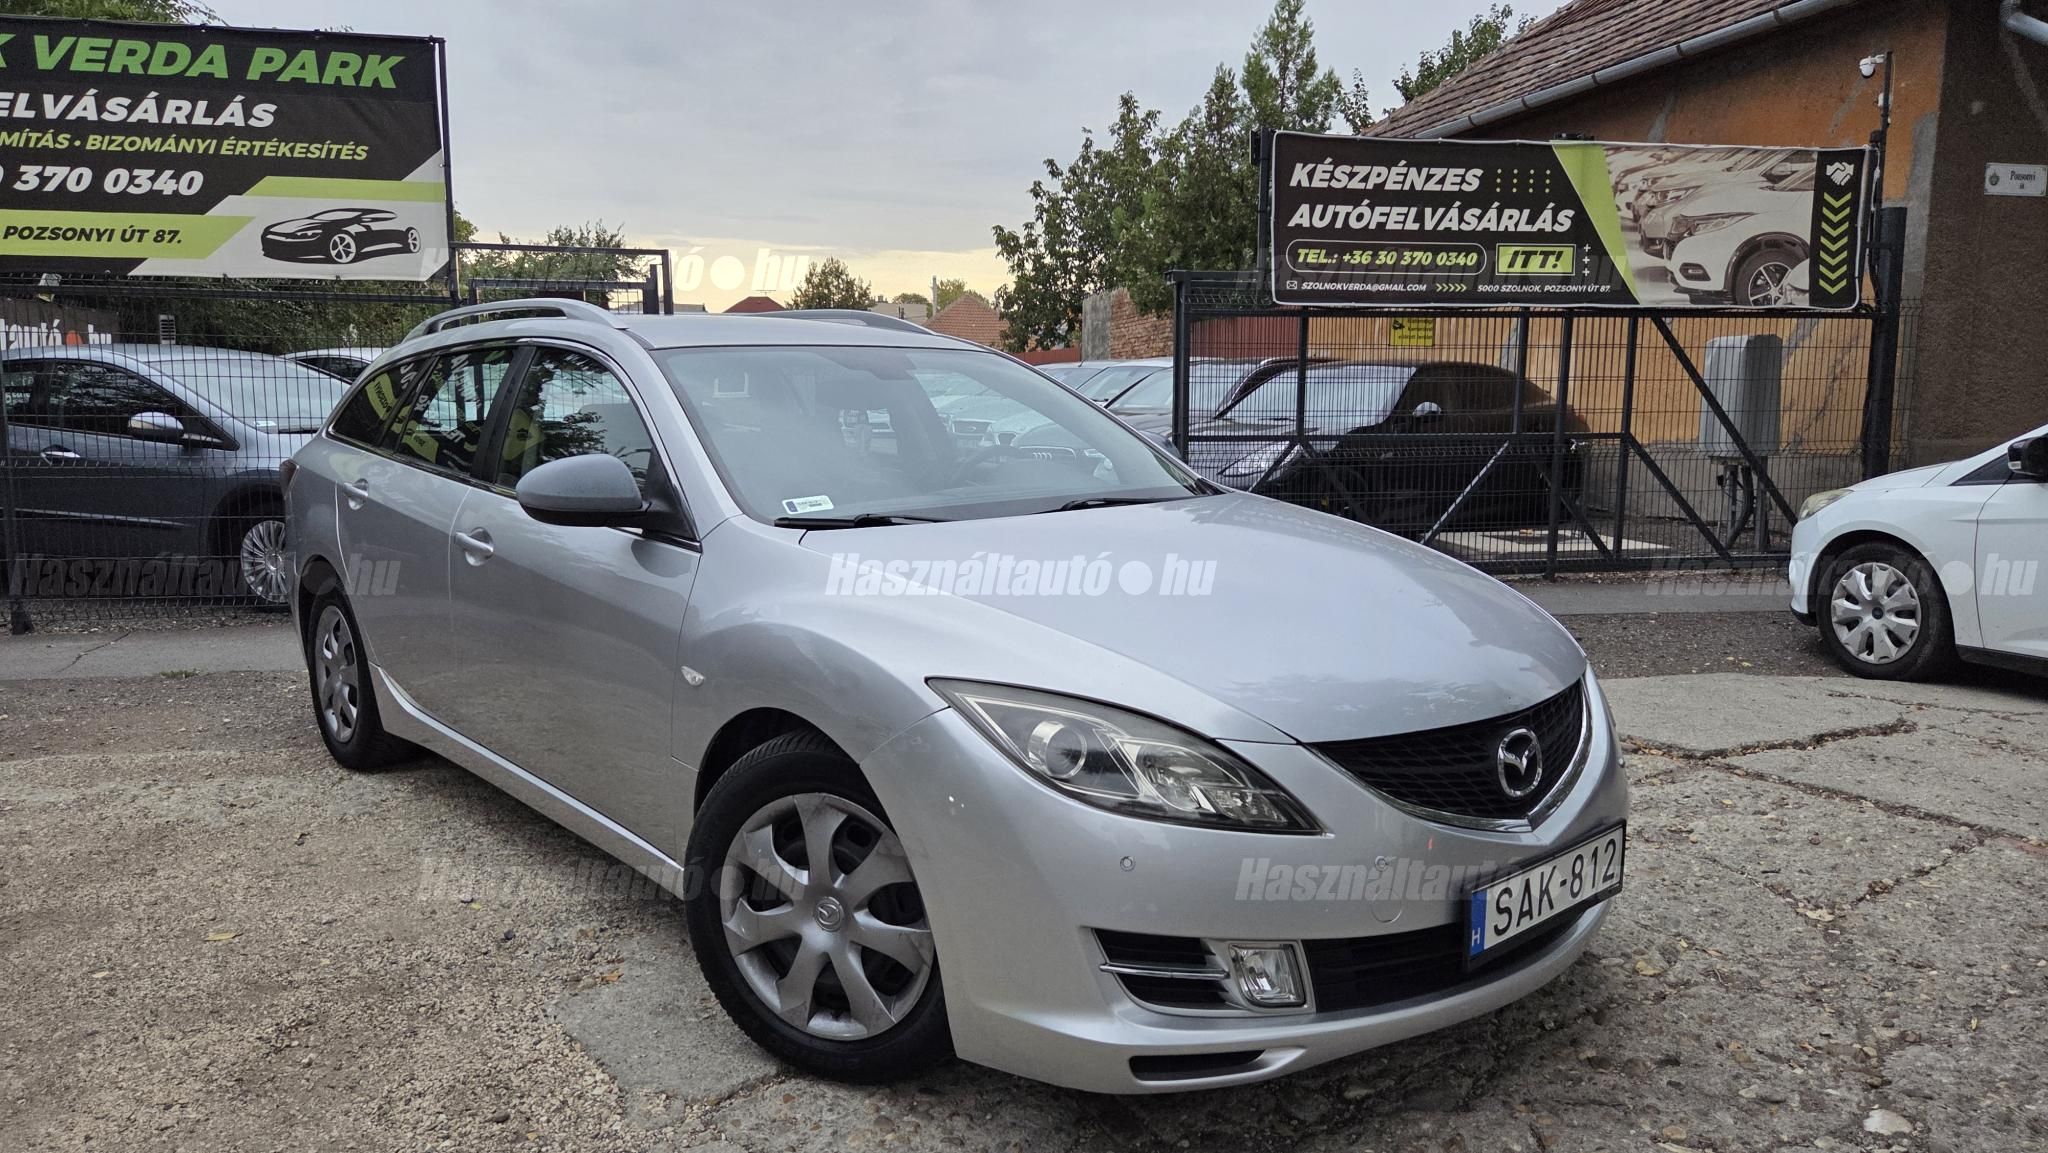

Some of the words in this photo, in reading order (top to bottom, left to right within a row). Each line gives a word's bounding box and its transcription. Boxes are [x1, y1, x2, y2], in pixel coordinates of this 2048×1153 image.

[34, 34, 229, 79] VERDA
[247, 48, 406, 89] PARK
[85, 131, 217, 155] BIZOMÁNYI
[220, 136, 369, 161] ÉRTÉKESÍTÉS
[13, 165, 93, 192] 370
[103, 167, 204, 196] 0340
[1289, 157, 1484, 192] KÉSZPÉNZES
[1287, 199, 1576, 233] AUTÓFELVÁSÁRLÁS
[3, 225, 116, 242] POZSONYI
[120, 225, 149, 243] ÚT
[153, 229, 182, 245] 87.
[1297, 248, 1338, 264] TEL.:
[1342, 250, 1372, 265] +36
[1375, 251, 1397, 265] 30
[1400, 251, 1432, 266] 370
[1436, 252, 1478, 266] 0340
[1507, 250, 1564, 269] ITT!
[1301, 281, 1427, 292] SZOLNOKVERDA@GMAIL.COM
[1543, 284, 1586, 293] POZSONYI
[1587, 282, 1599, 293] ÚT
[1493, 838, 1617, 937] SAK-812
[1471, 927, 1481, 947] H
